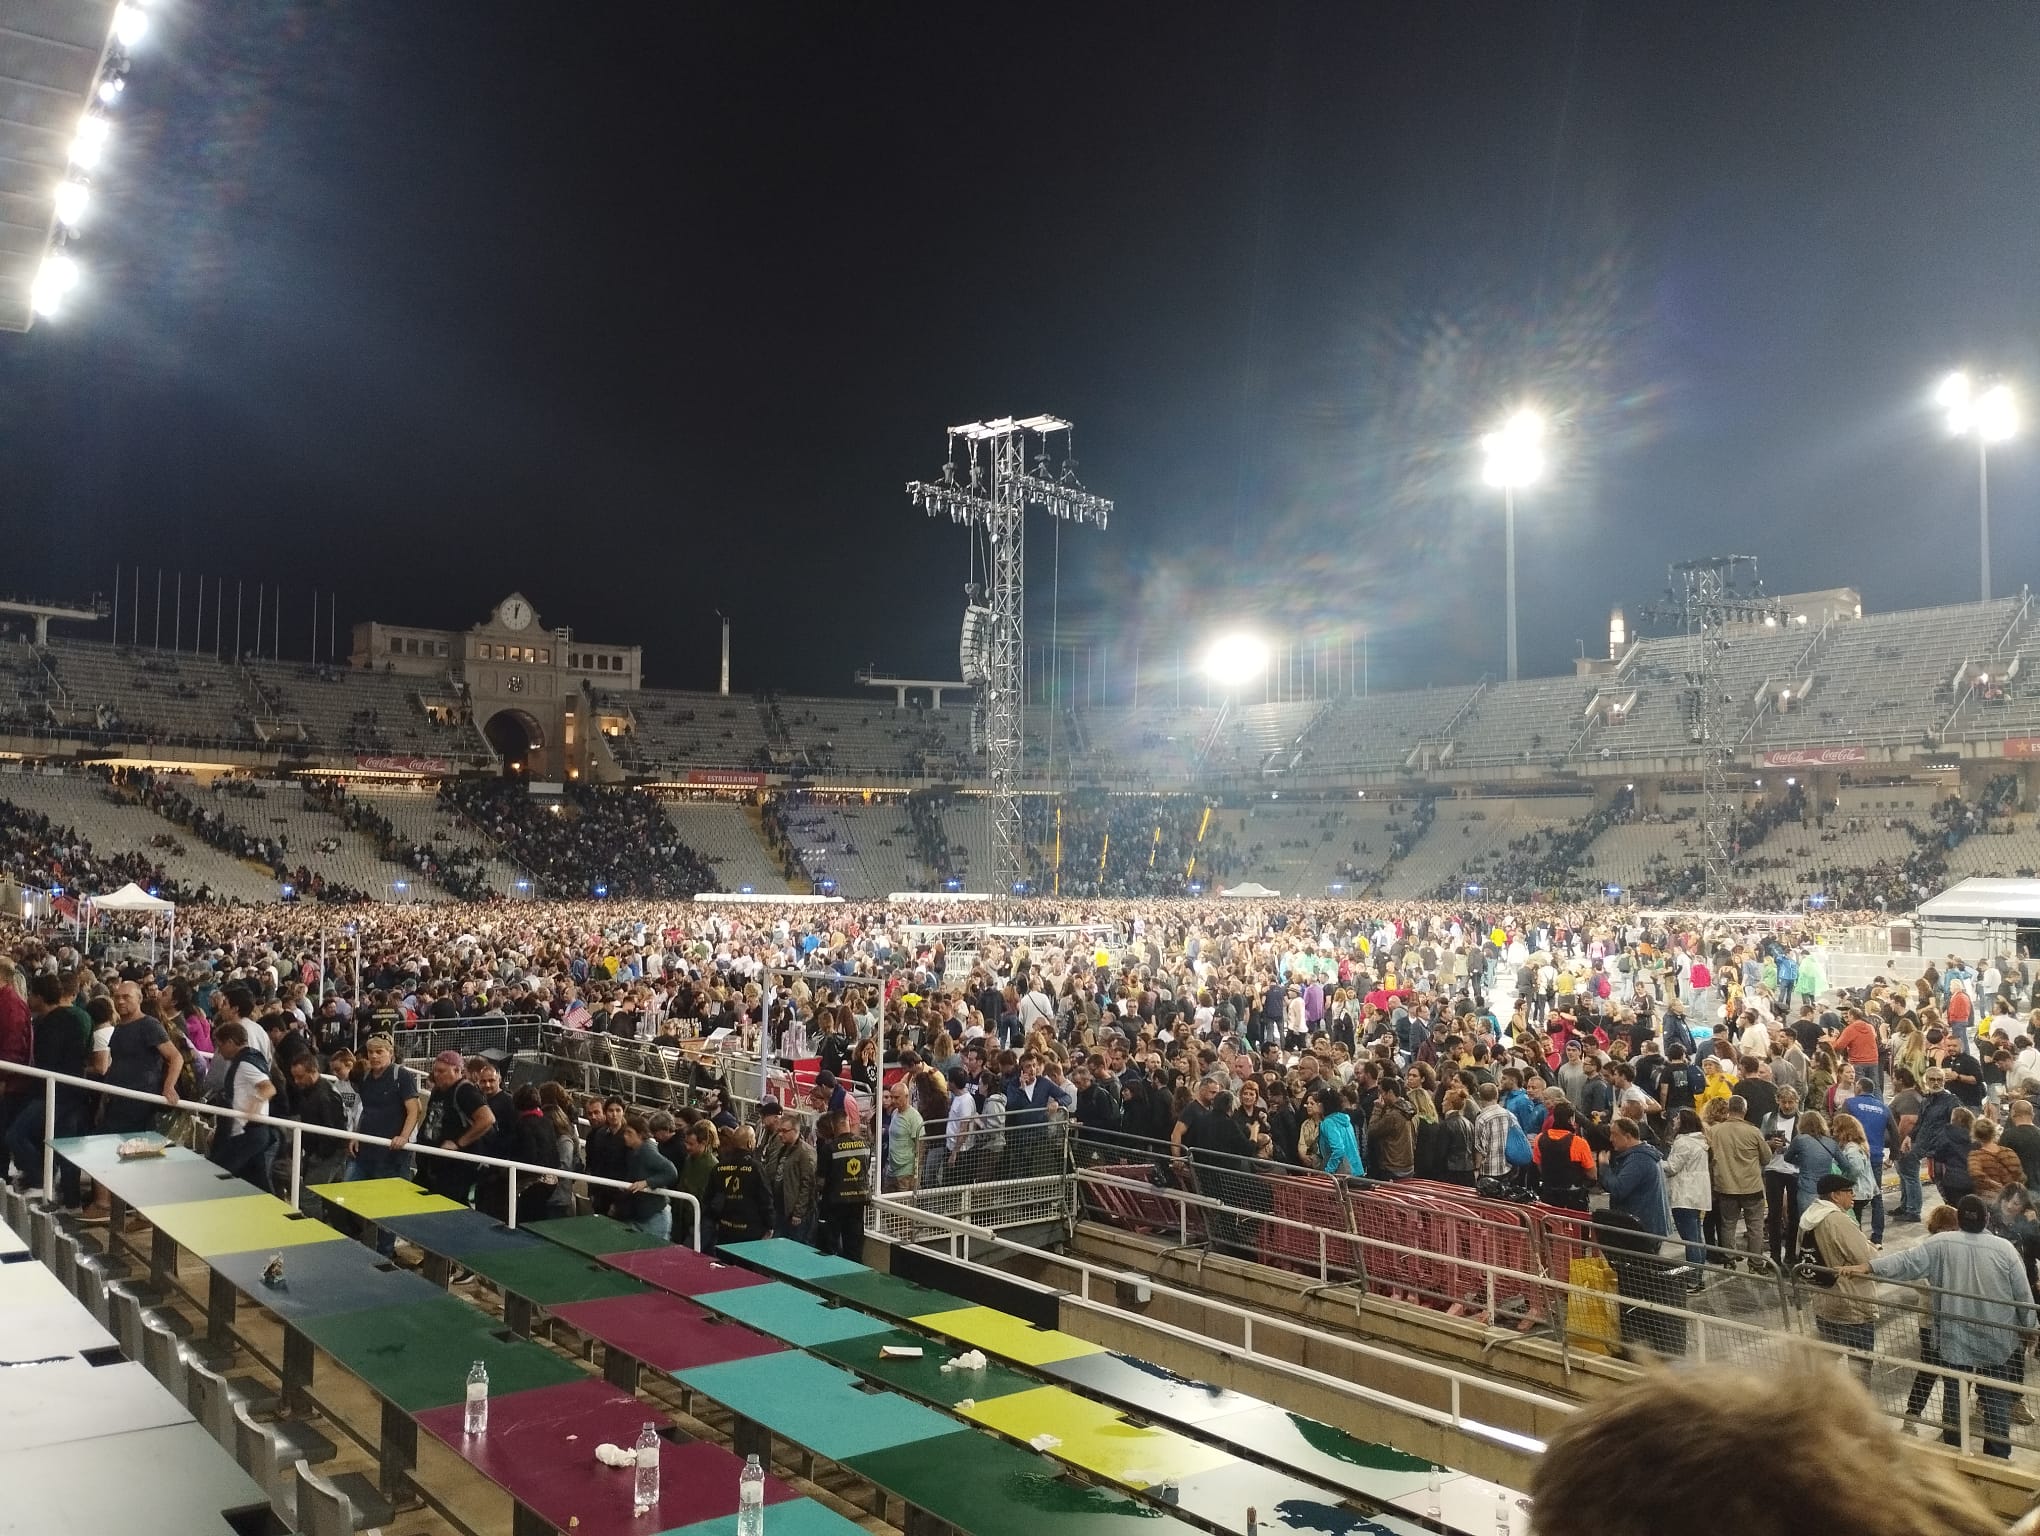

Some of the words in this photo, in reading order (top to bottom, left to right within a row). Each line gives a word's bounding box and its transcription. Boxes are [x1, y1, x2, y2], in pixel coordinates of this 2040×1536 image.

[707, 775, 738, 783] ESTRELLA
[738, 776, 759, 784] DAMM
[837, 1141, 866, 1150] CONTROL
